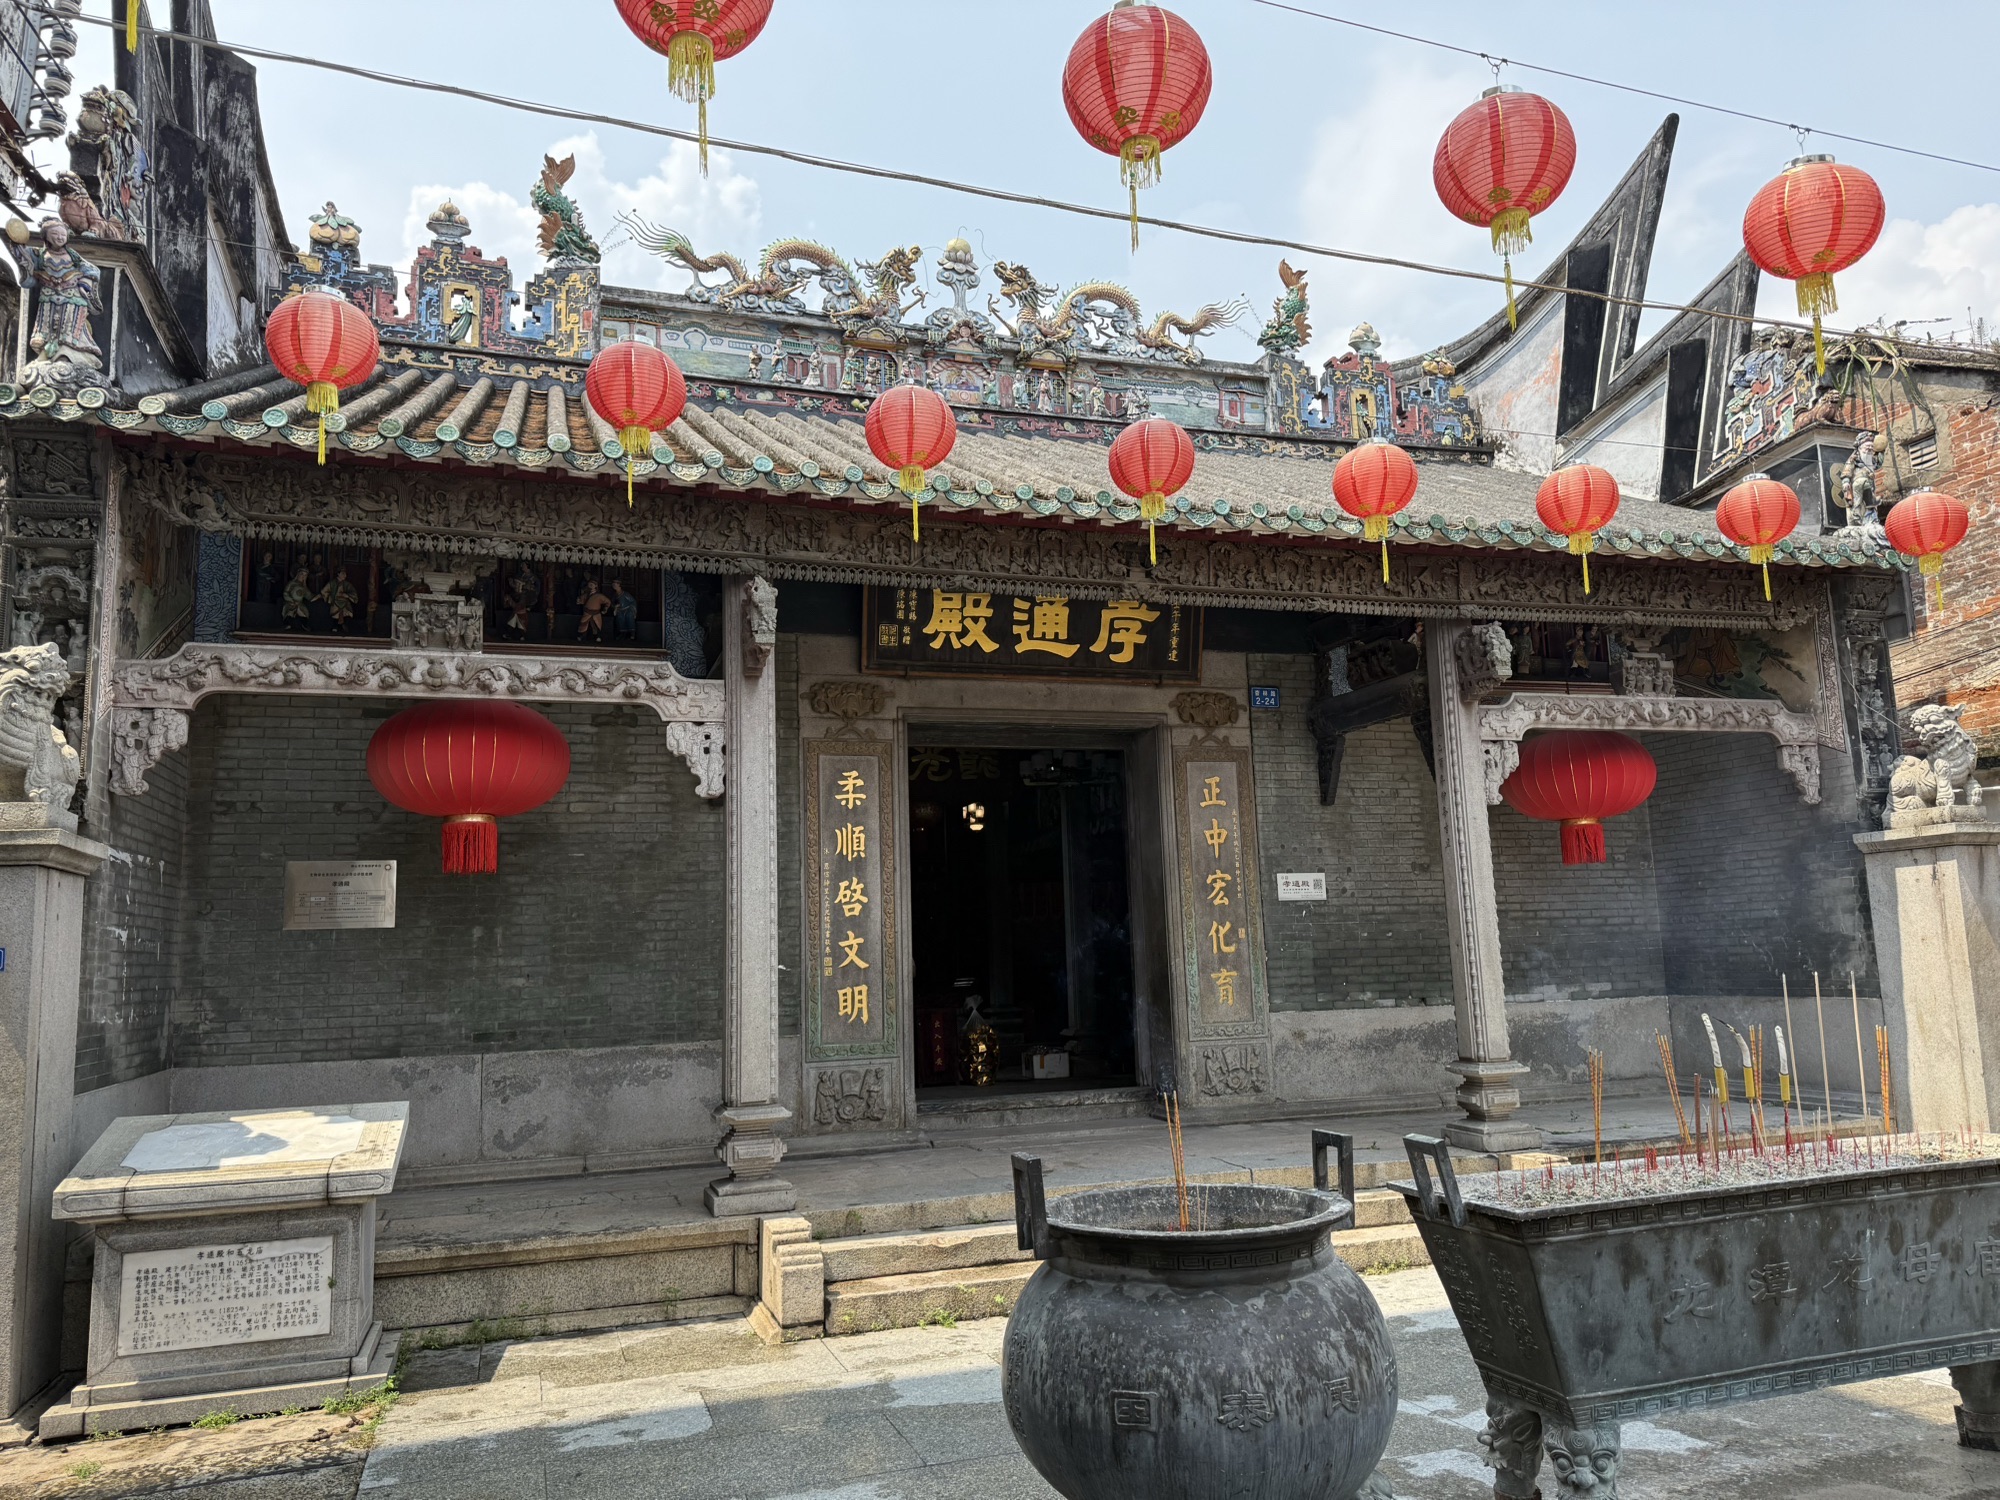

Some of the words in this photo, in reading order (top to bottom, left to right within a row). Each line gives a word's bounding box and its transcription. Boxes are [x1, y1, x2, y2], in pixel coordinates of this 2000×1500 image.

[1255, 697, 1275, 705] 2-24
[1282, 880, 1310, 888] 孝通殿
[1199, 776, 1239, 1007] 正中宏化育
